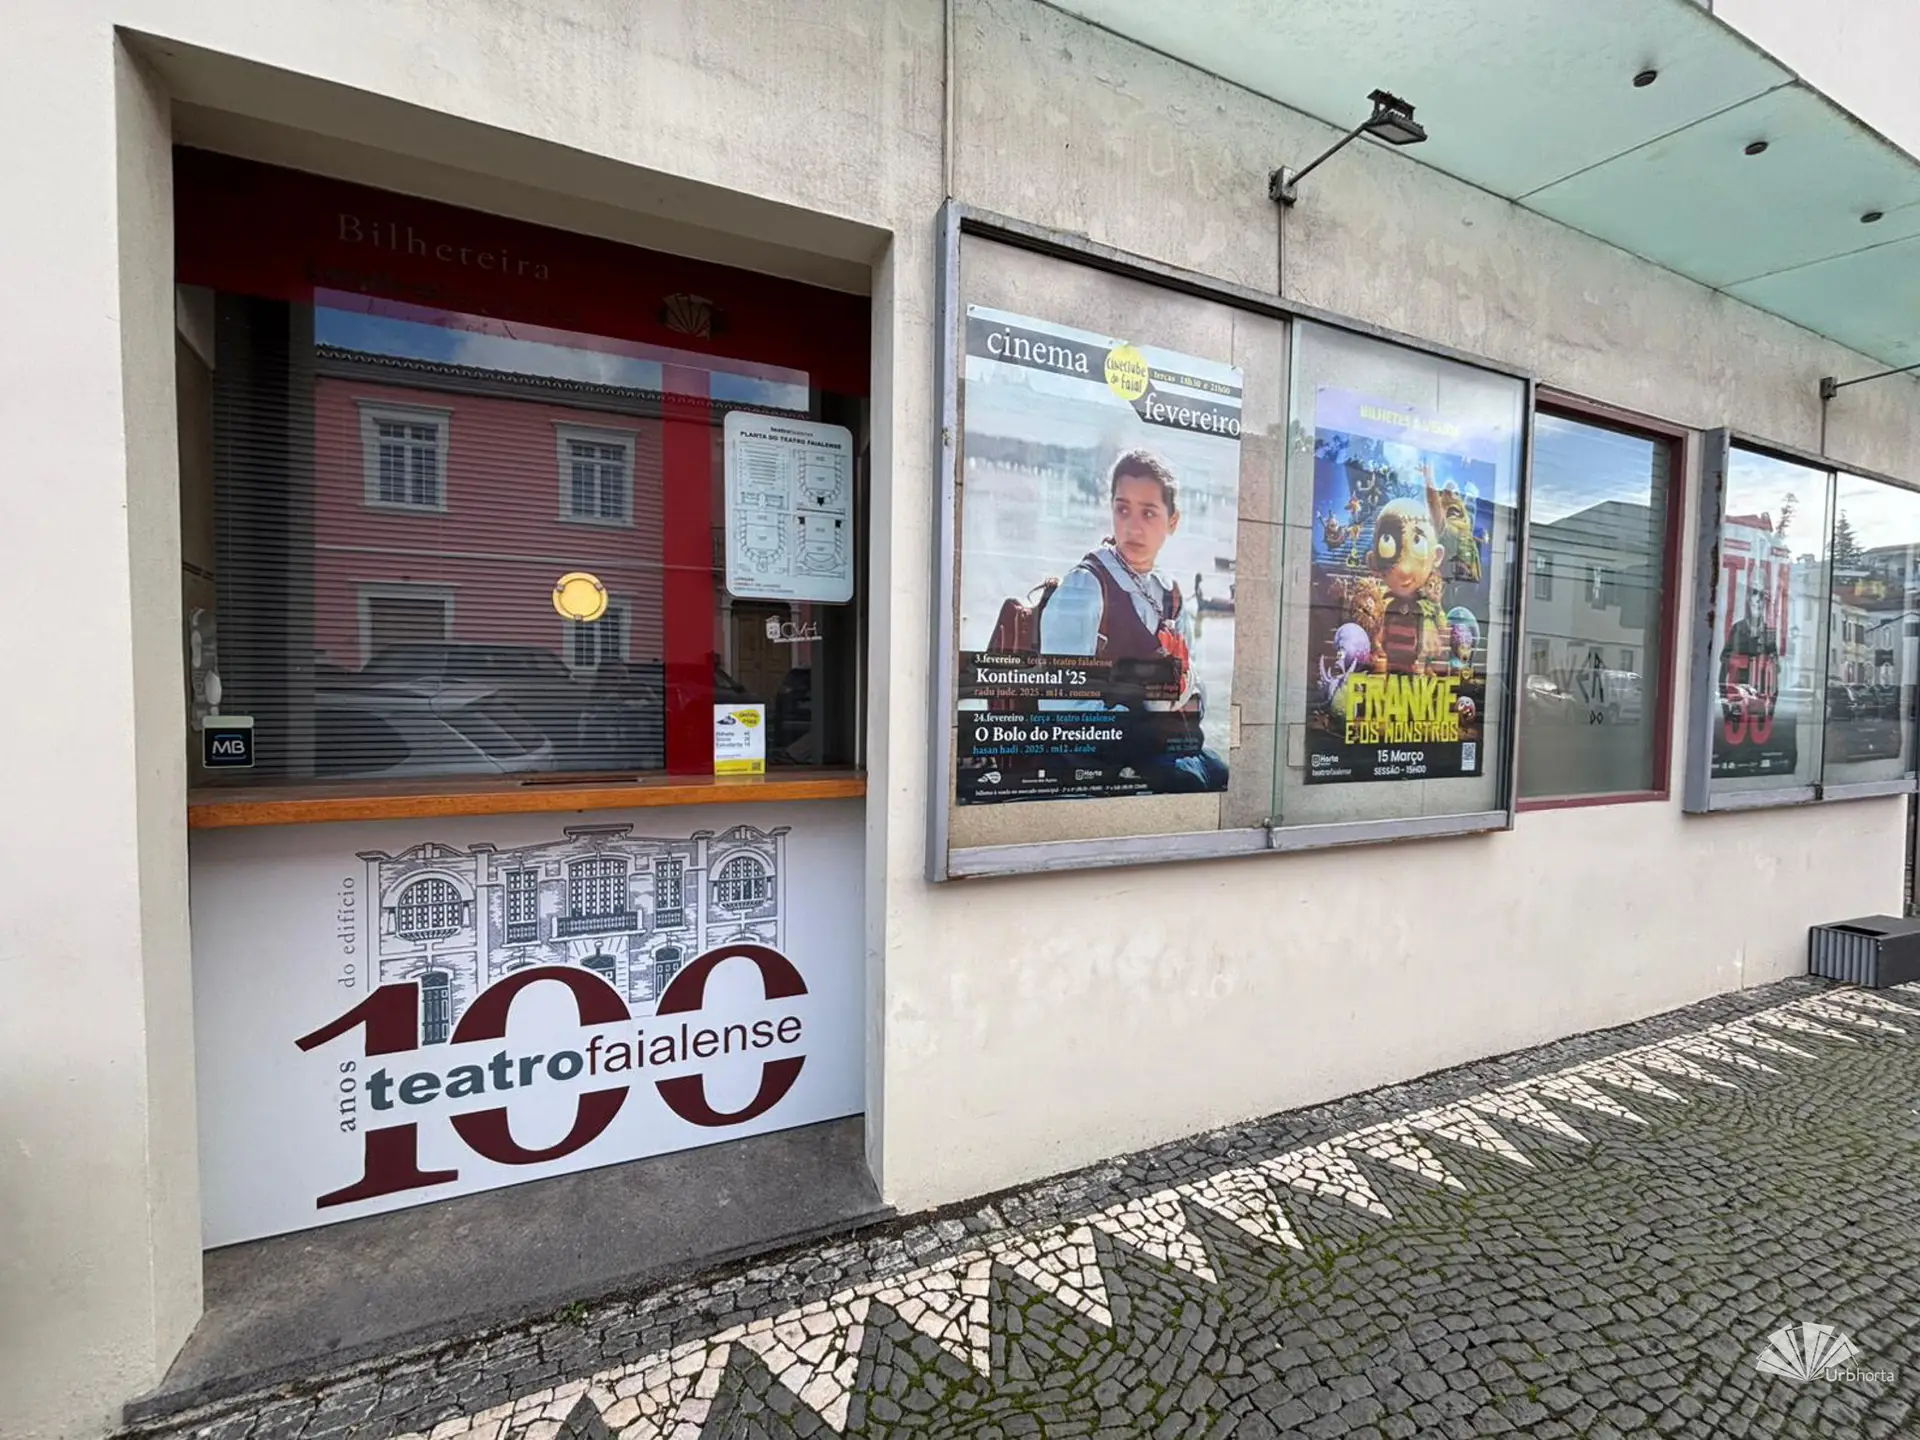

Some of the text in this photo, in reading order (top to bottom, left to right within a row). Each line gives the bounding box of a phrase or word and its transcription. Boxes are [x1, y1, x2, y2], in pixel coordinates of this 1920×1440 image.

[336, 213, 550, 281] Bilheteira
[987, 327, 1089, 374] cinema
[1144, 392, 1240, 436] fevereiro
[740, 431, 767, 440] PLANTA
[780, 436, 806, 446] TEATRO
[807, 440, 842, 450] FAIALENSE
[976, 668, 1063, 684] Kontinental
[1020, 687, 1040, 696] 2025
[1346, 671, 1461, 722] FRANKIE
[1056, 714, 1080, 722] teatro
[975, 726, 1123, 742] O Bolo do Presidente
[1345, 721, 1460, 744] E OS MONSTROS
[212, 740, 245, 754] MB
[1024, 744, 1044, 753] 2025
[1377, 750, 1424, 765] 15 Março
[338, 964, 355, 988] do
[294, 944, 808, 1210] 100
[340, 1060, 356, 1133] anos
